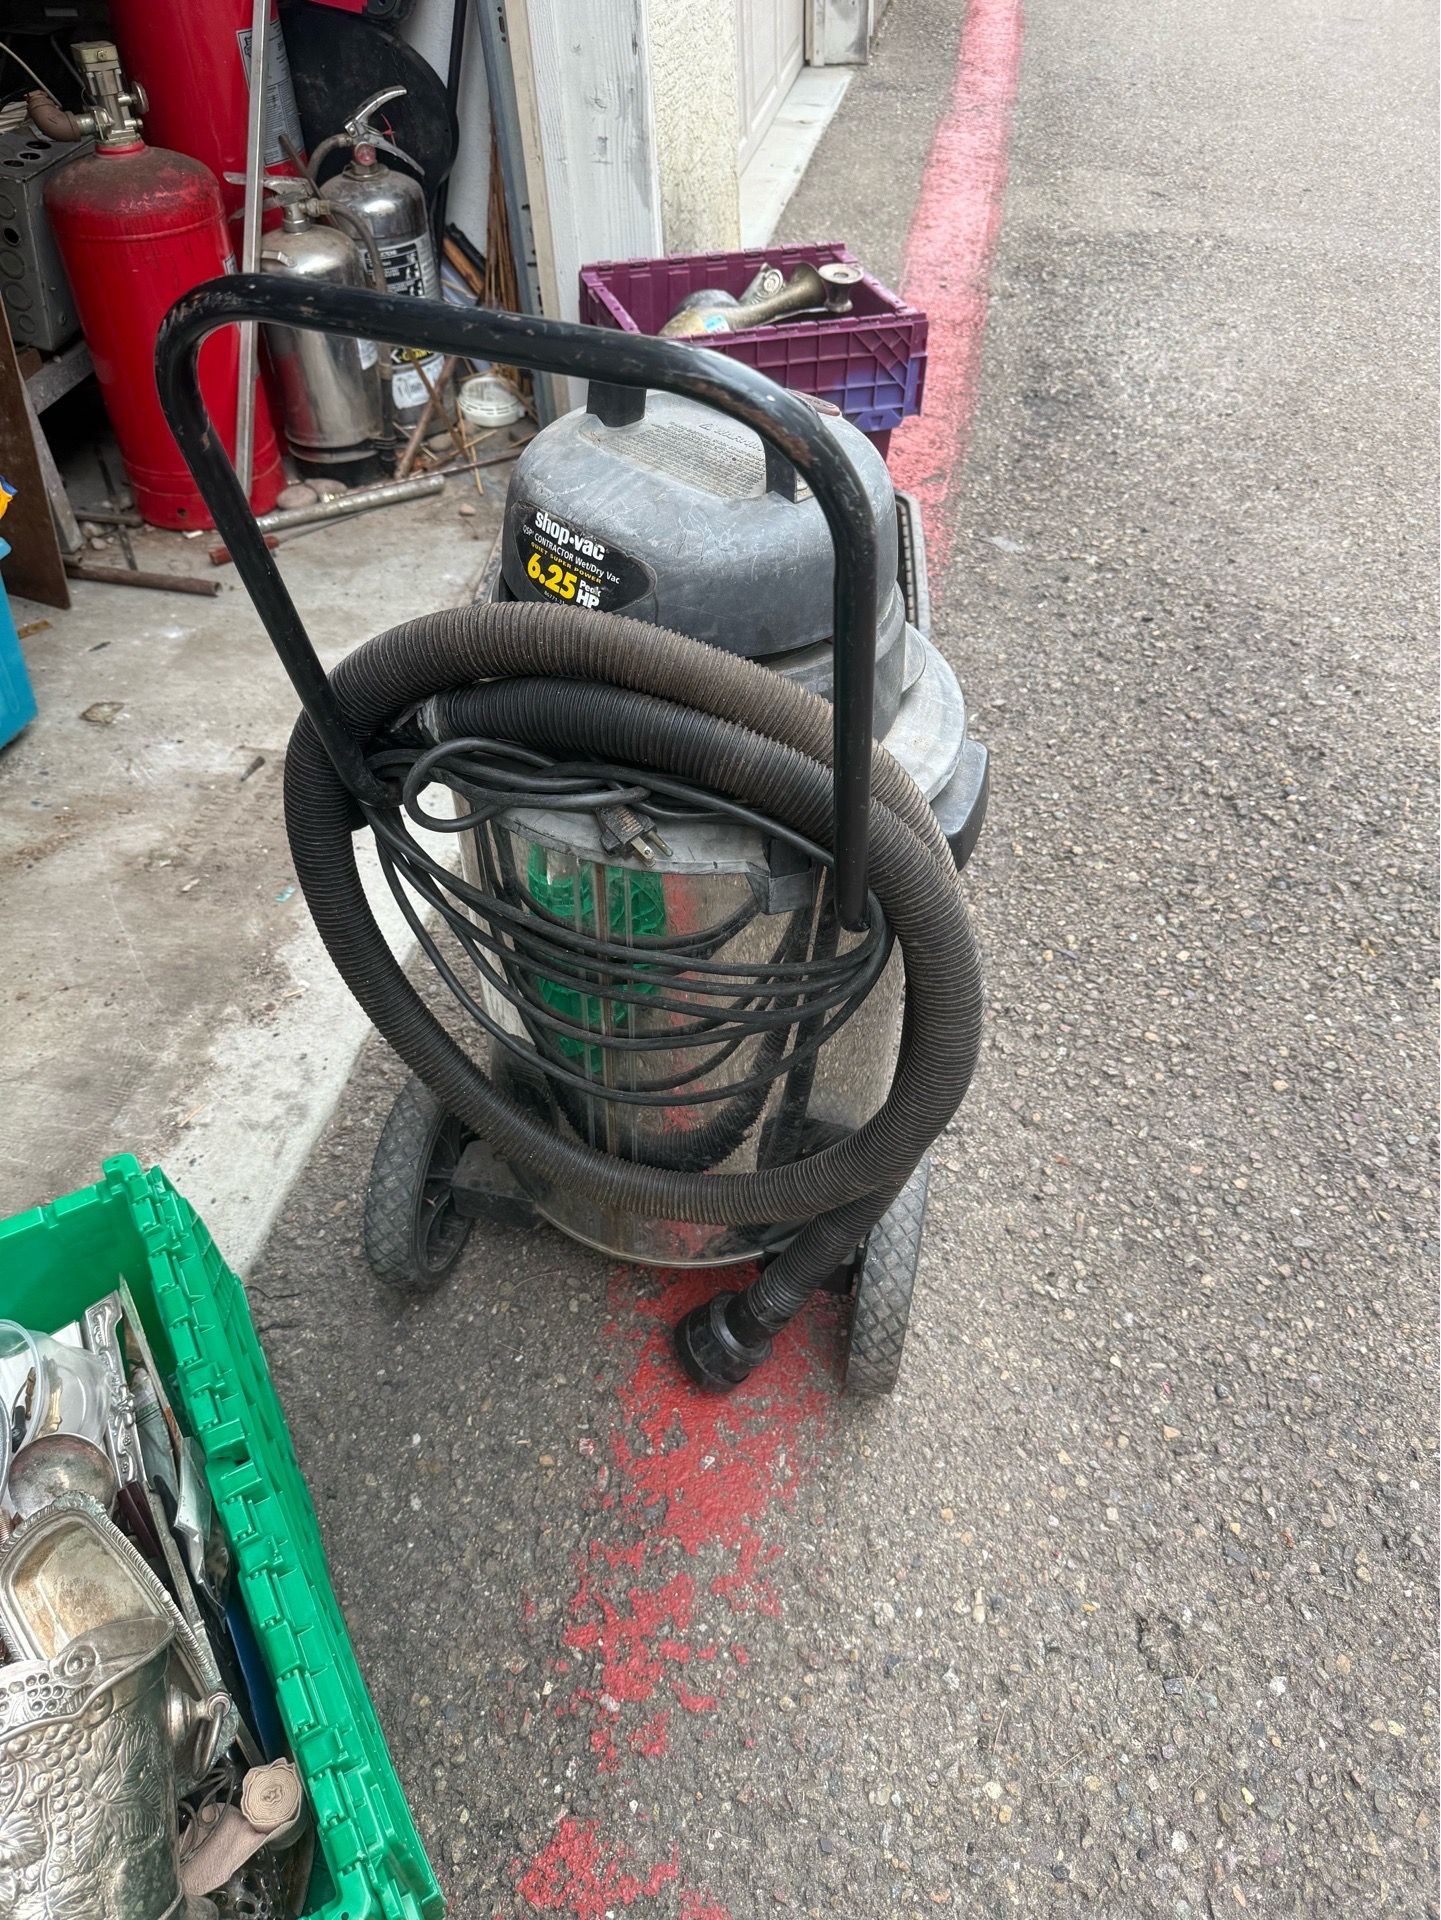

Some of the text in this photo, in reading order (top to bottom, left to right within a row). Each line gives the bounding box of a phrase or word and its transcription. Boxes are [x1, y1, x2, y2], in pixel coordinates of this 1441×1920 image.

[534, 533, 574, 562] CONTRACTOR
[575, 556, 605, 578] Wet/Dry
[606, 571, 620, 584] Vac
[549, 553, 572, 569] SUPER
[574, 566, 602, 584] POWER
[528, 553, 577, 599] 6.25
[579, 580, 601, 597] Peak
[576, 588, 600, 609] HP
